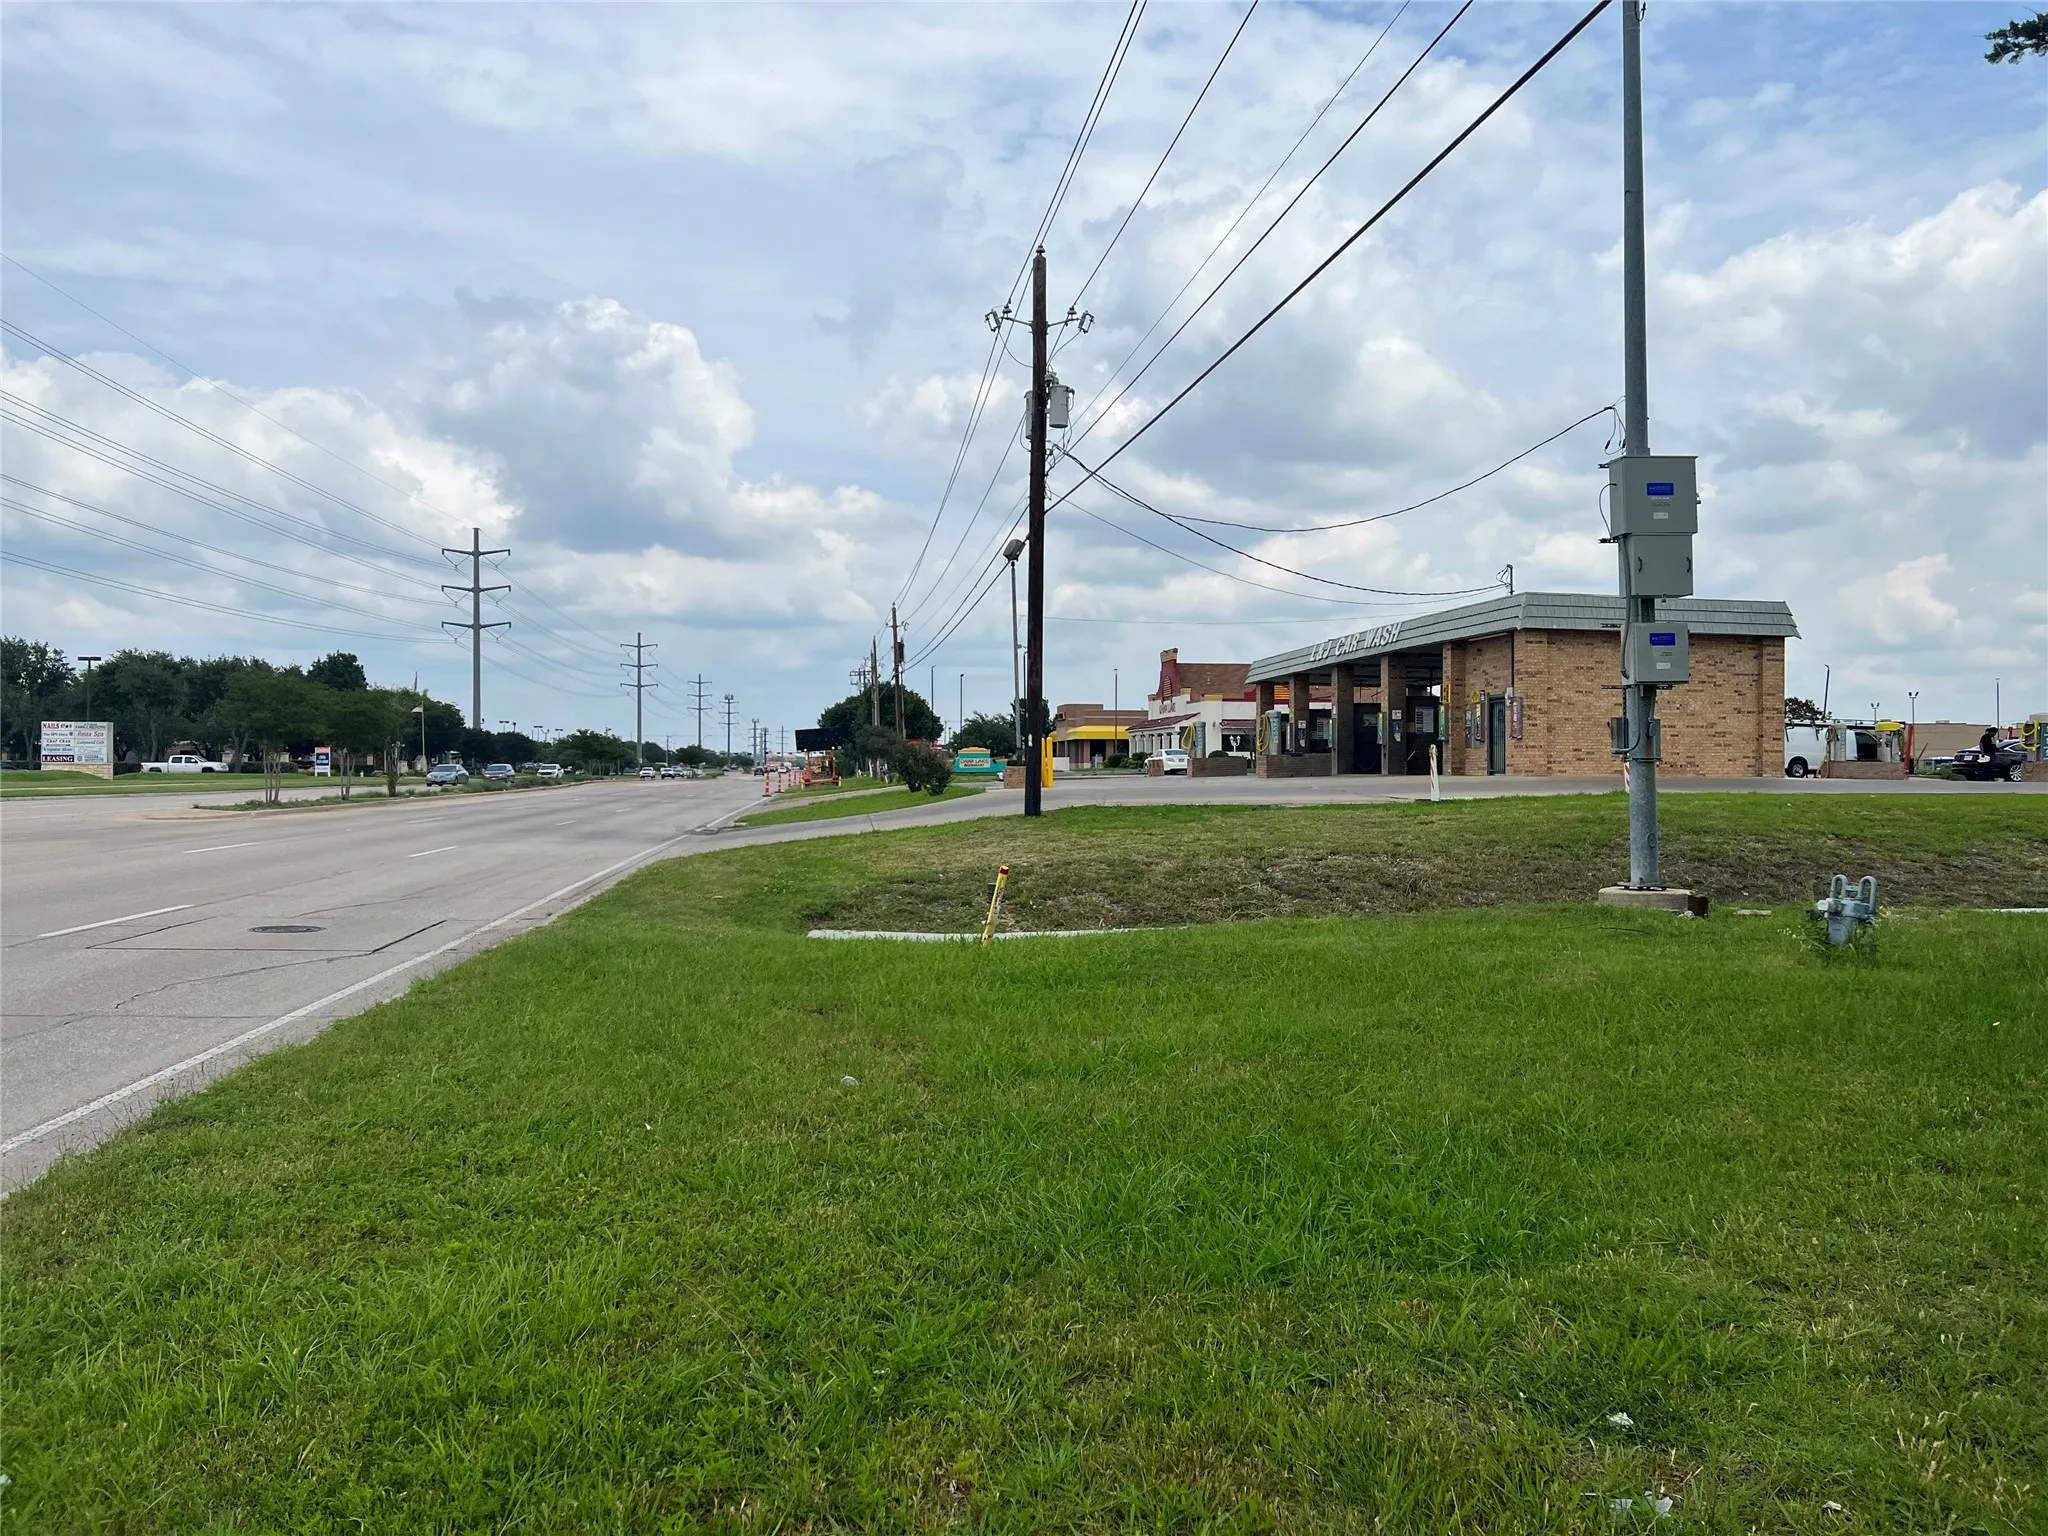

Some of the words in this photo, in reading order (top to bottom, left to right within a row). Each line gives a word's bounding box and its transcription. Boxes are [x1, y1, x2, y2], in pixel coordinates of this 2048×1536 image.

[1310, 641, 1333, 661] L&J
[1335, 633, 1360, 656] CAR
[1364, 622, 1403, 648] WASH
